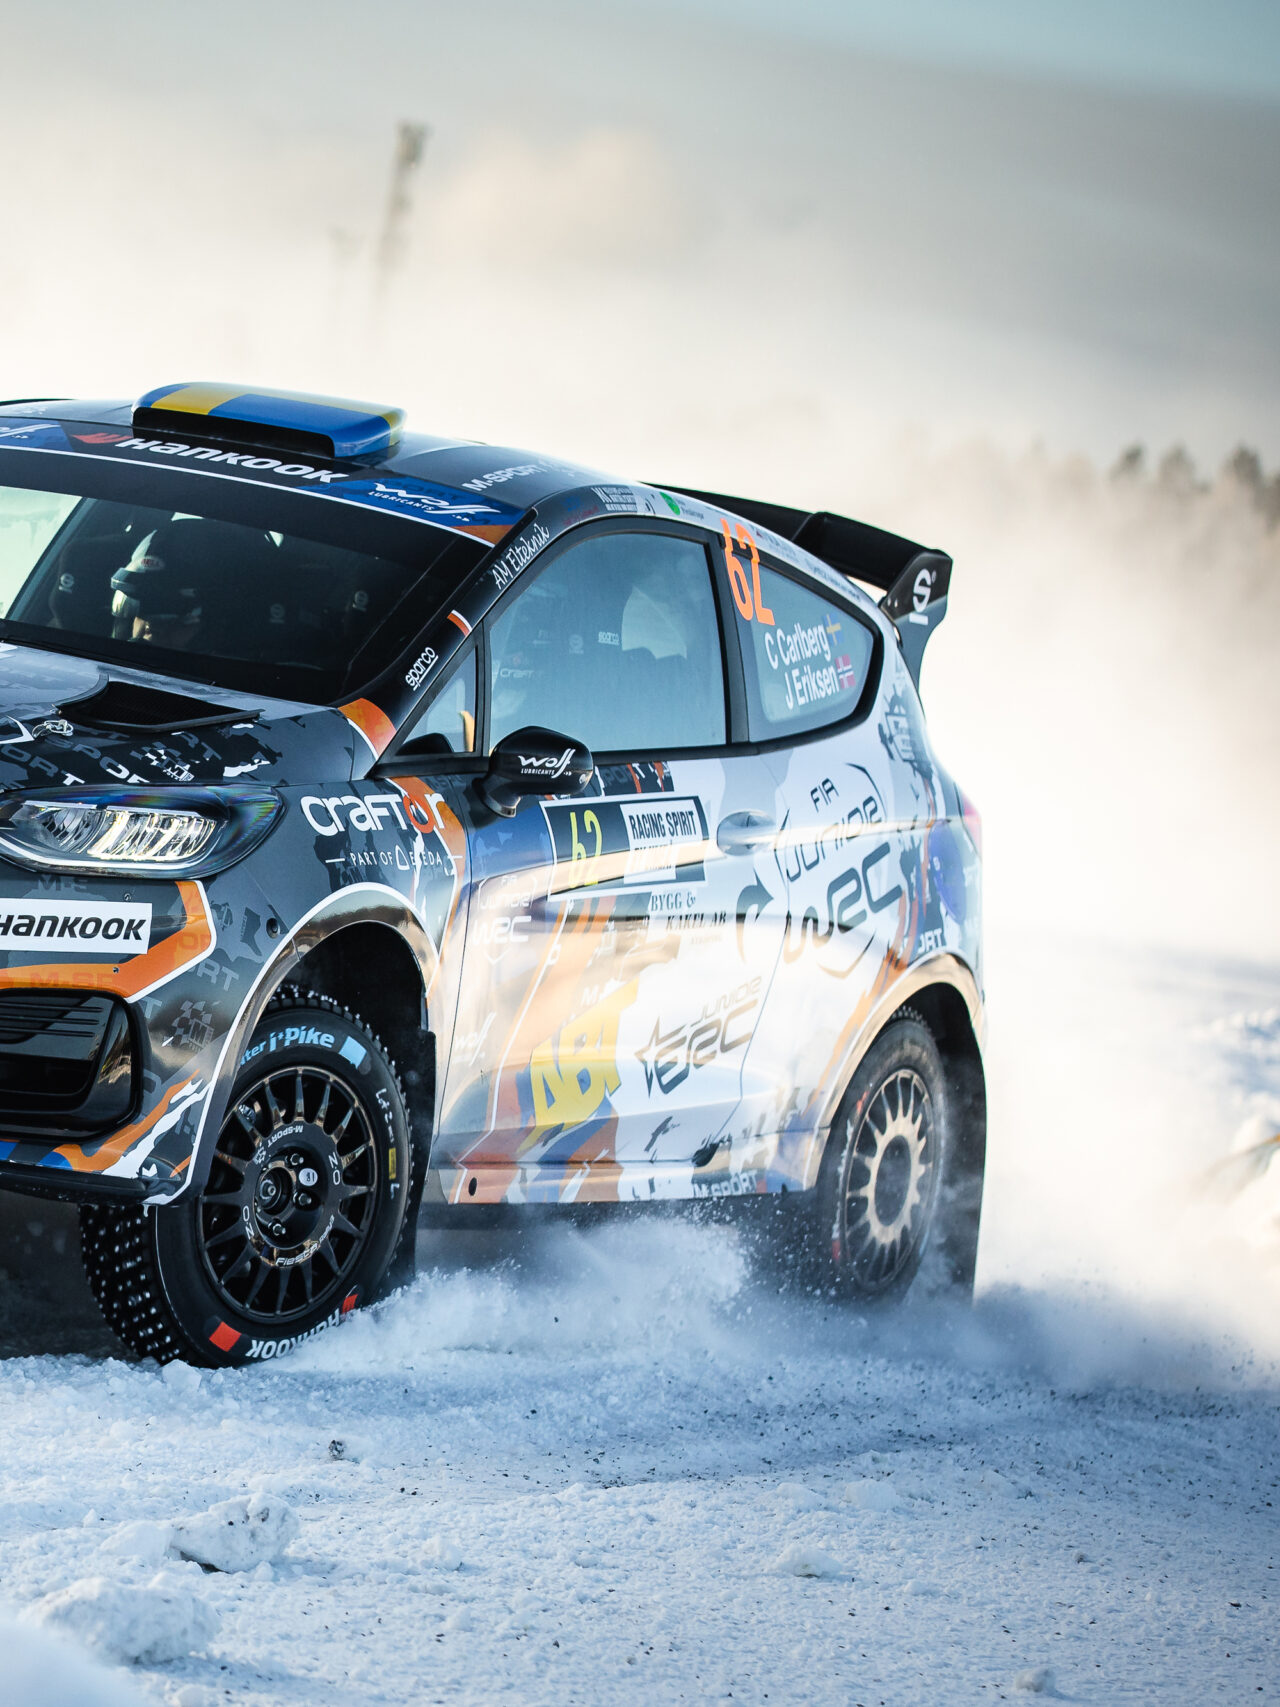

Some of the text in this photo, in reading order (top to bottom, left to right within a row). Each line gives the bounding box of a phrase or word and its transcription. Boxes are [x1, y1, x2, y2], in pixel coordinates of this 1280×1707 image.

[492, 523, 550, 590] AM Elteknik
[720, 517, 776, 626] 62
[405, 646, 439, 691] sparco
[764, 622, 832, 670] C Carlberg
[784, 662, 841, 711] J Eriksen
[518, 748, 576, 779] wolf
[521, 768, 556, 776] LUBRICANTS
[810, 777, 840, 813] FIA
[628, 810, 697, 840] RACING SPIRIT
[786, 795, 883, 883] JUNIOR
[350, 850, 379, 866] PART
[379, 851, 394, 866] OF
[570, 809, 603, 889] 62
[651, 892, 683, 912] BYGG
